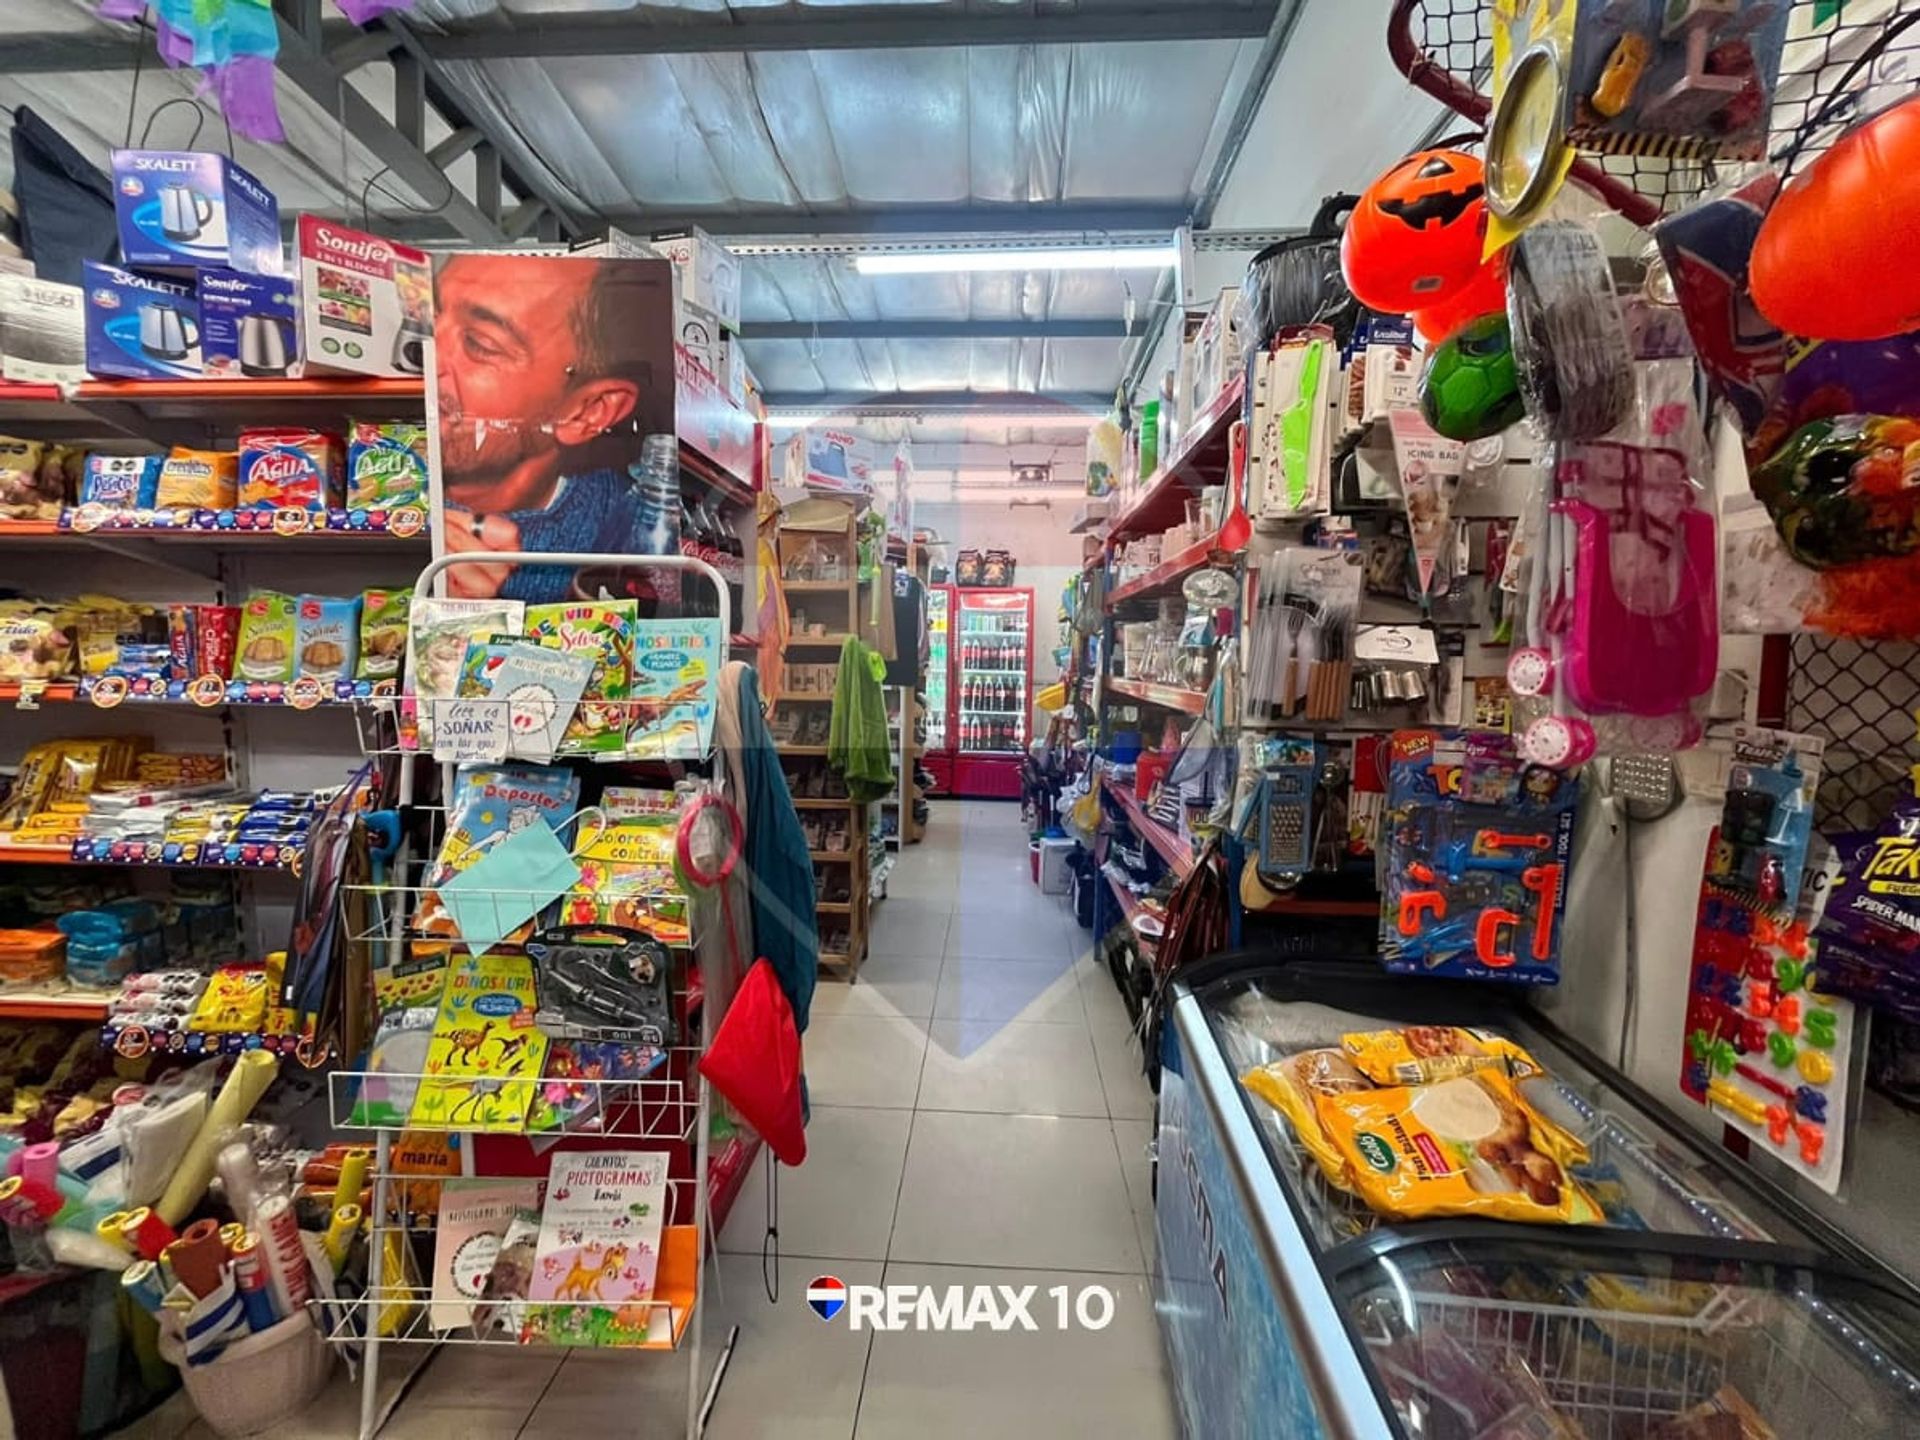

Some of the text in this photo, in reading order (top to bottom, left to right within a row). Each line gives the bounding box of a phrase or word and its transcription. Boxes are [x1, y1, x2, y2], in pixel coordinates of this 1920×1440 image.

[135, 158, 197, 172] SKALETT
[230, 169, 270, 207] SKALETT
[316, 228, 390, 263] Sonifer
[112, 272, 189, 297] SKALETT
[203, 275, 252, 292] Sonifer
[356, 455, 417, 478] AGUA
[1407, 450, 1435, 460] ICING
[253, 458, 315, 482] AGUA
[560, 622, 602, 653] Selva
[443, 718, 494, 735] SOÑAR
[1402, 735, 1430, 752] NEW
[484, 783, 561, 811] Deportes
[1560, 833, 1570, 858] TOOL
[585, 1156, 628, 1169] CUENTOS
[566, 1170, 652, 1186] PICTOGRAMAS
